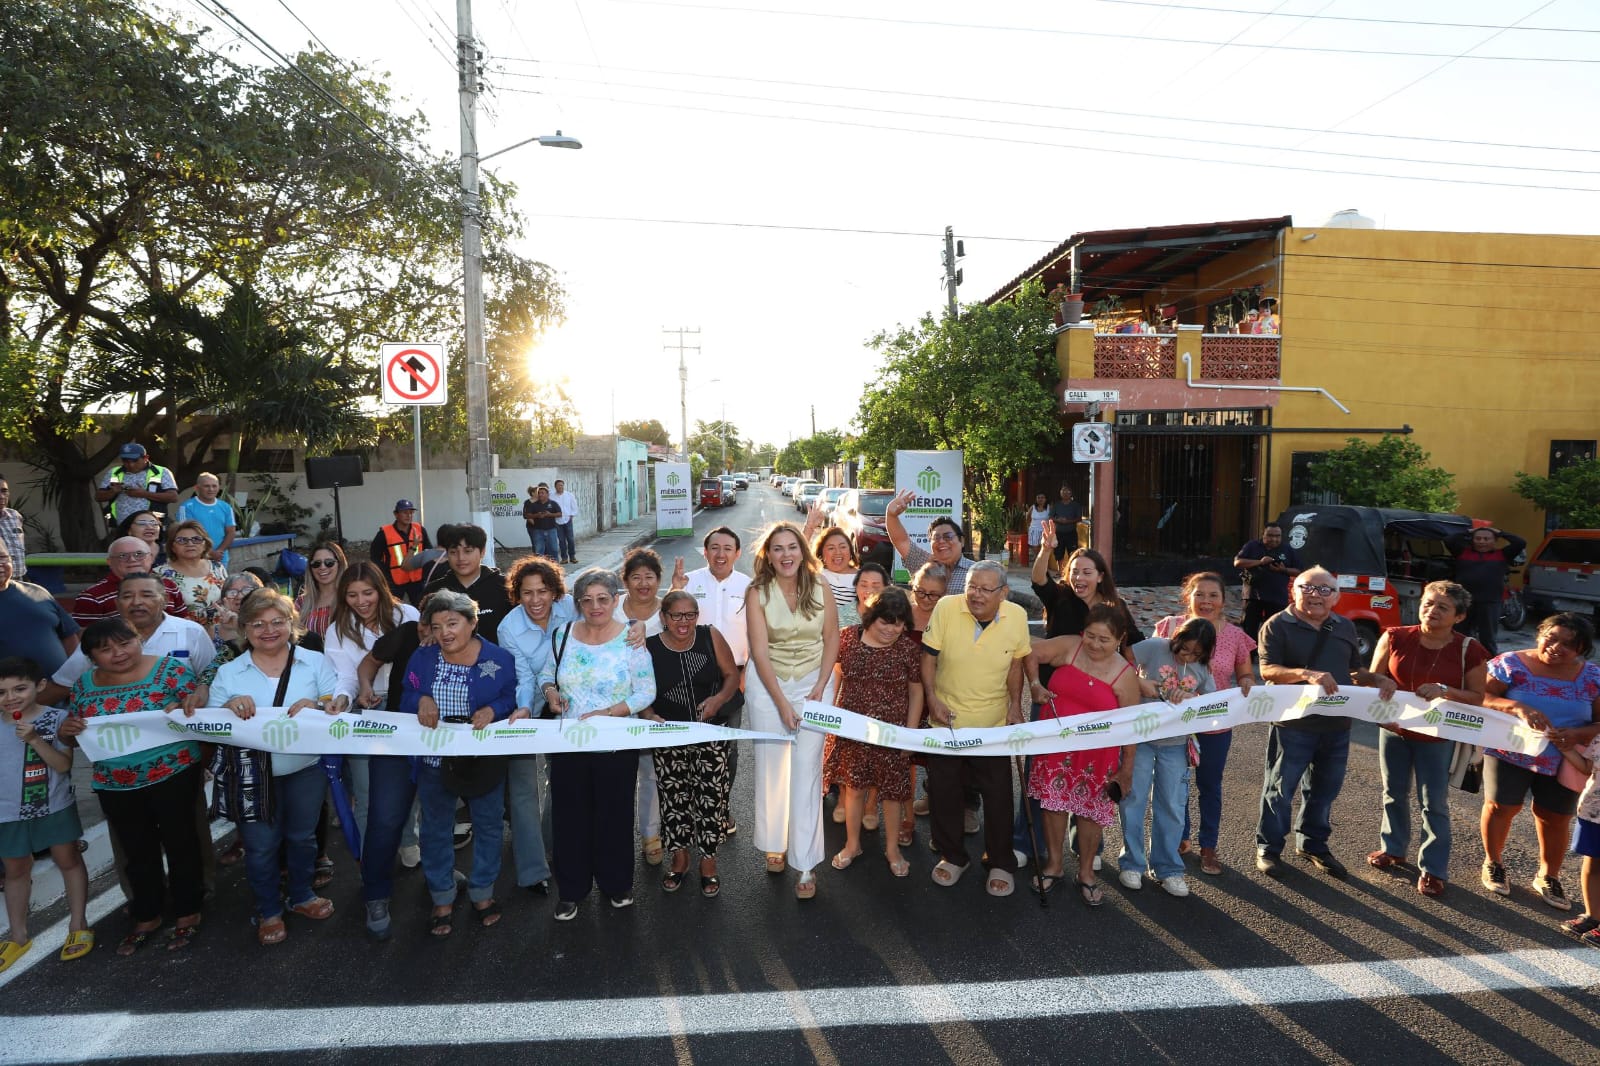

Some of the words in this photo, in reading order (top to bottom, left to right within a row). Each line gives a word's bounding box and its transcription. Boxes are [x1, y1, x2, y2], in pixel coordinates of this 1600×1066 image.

[803, 711, 842, 725] MÉRIDA
[186, 721, 232, 732] MÉRIDA
[353, 719, 398, 731] MÉRIDA
